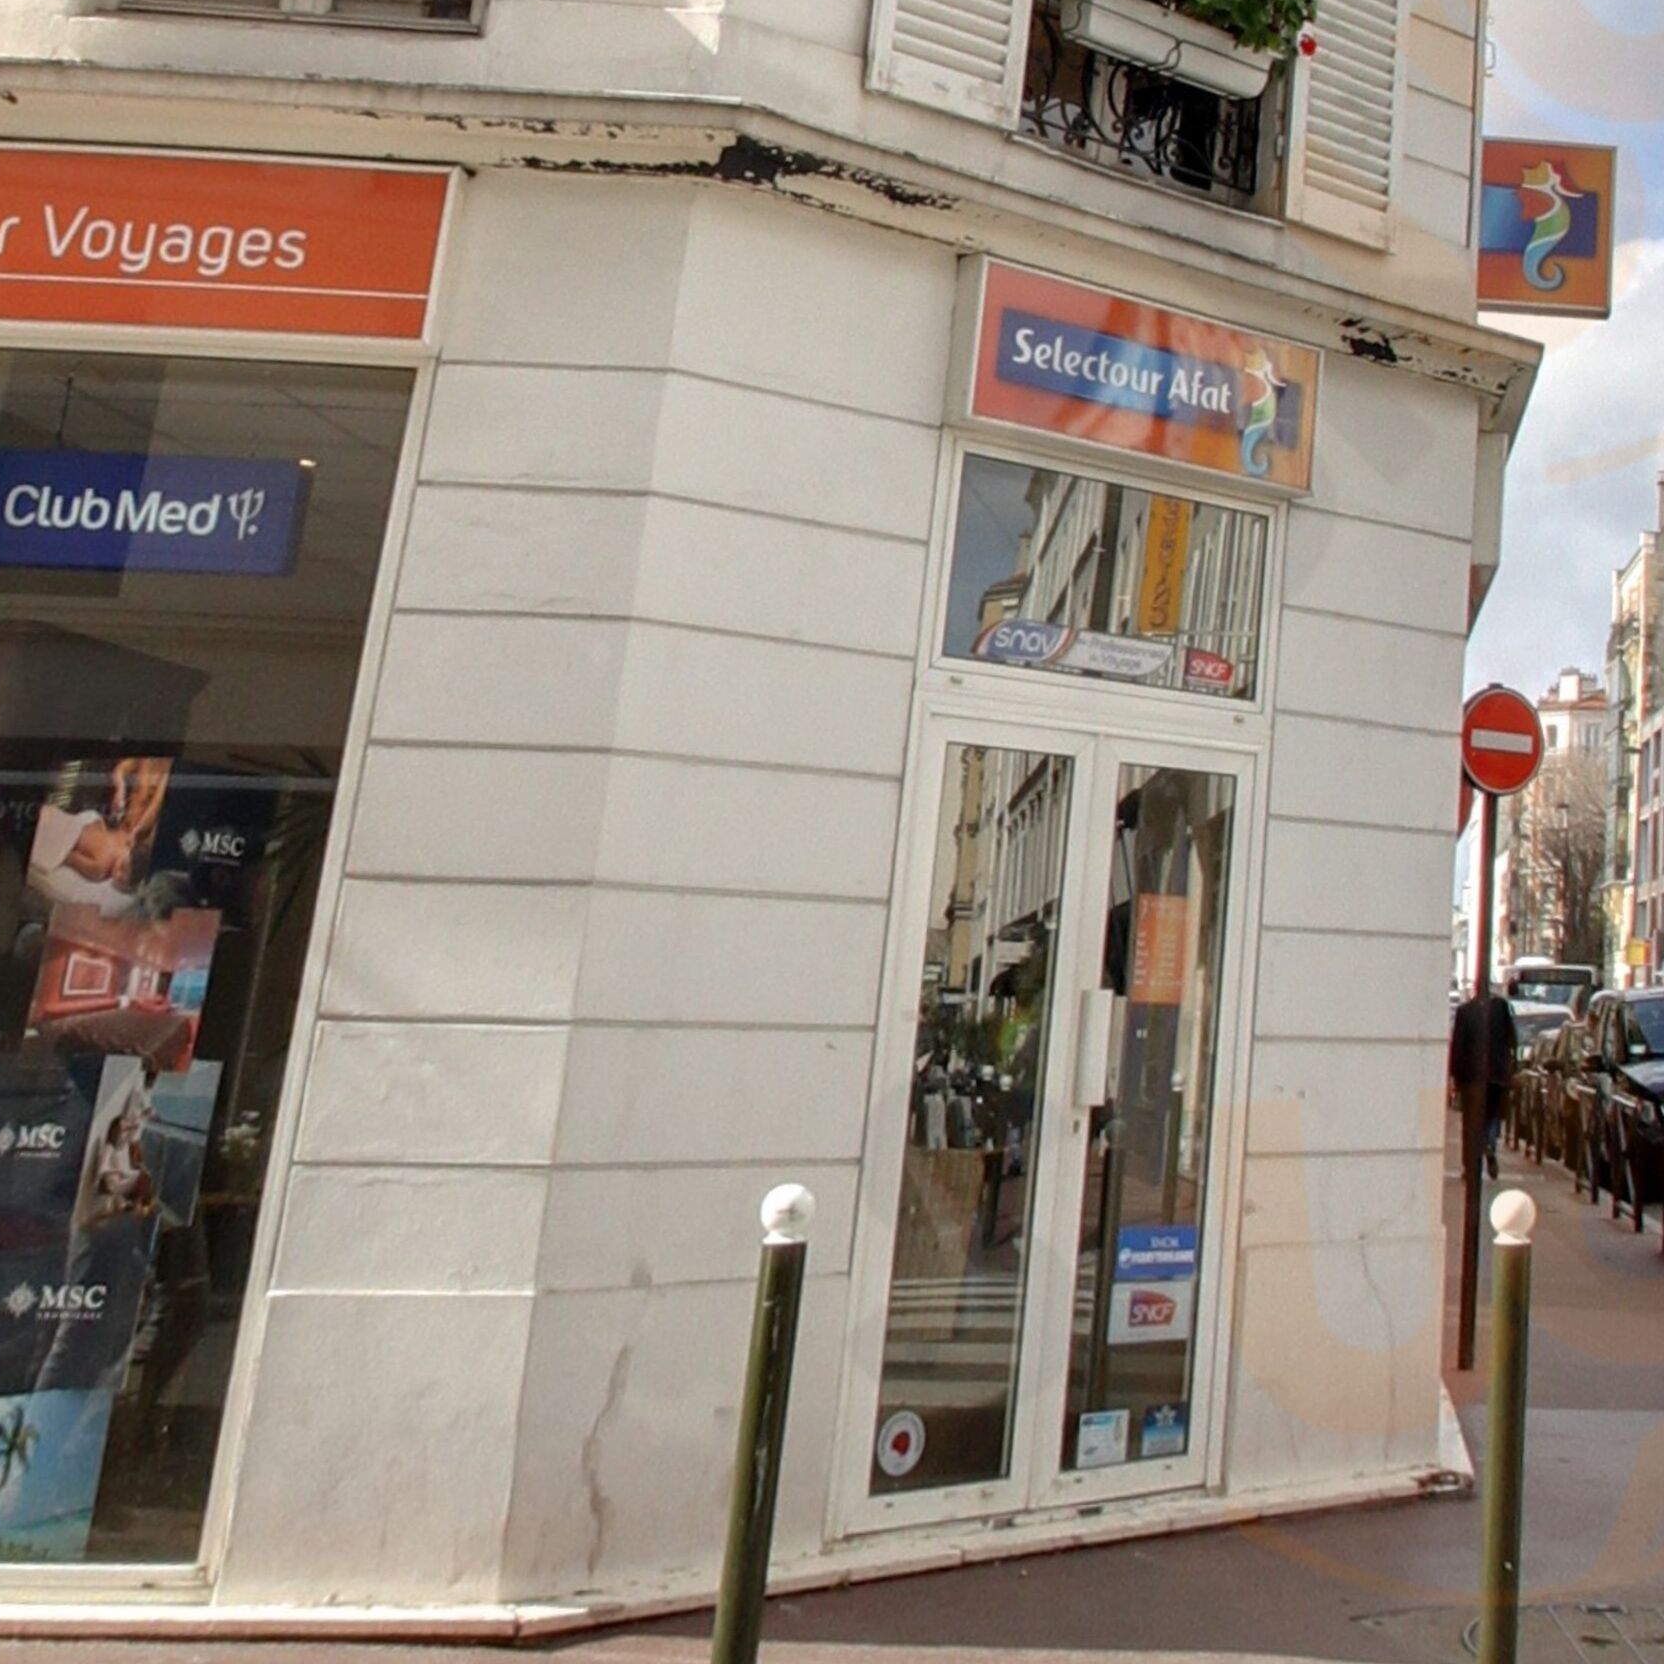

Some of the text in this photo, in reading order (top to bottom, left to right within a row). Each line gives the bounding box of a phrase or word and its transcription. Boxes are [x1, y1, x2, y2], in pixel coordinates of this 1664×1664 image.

[42, 204, 308, 277] Voyages
[1012, 327, 1233, 414] Selectour Afat
[3, 484, 223, 536] Club Med
[1189, 658, 1228, 678] SNCF
[200, 831, 246, 857] MSC
[16, 1122, 66, 1149] MSC
[39, 1285, 107, 1310] MSC
[1131, 1302, 1174, 1324] SNCF
